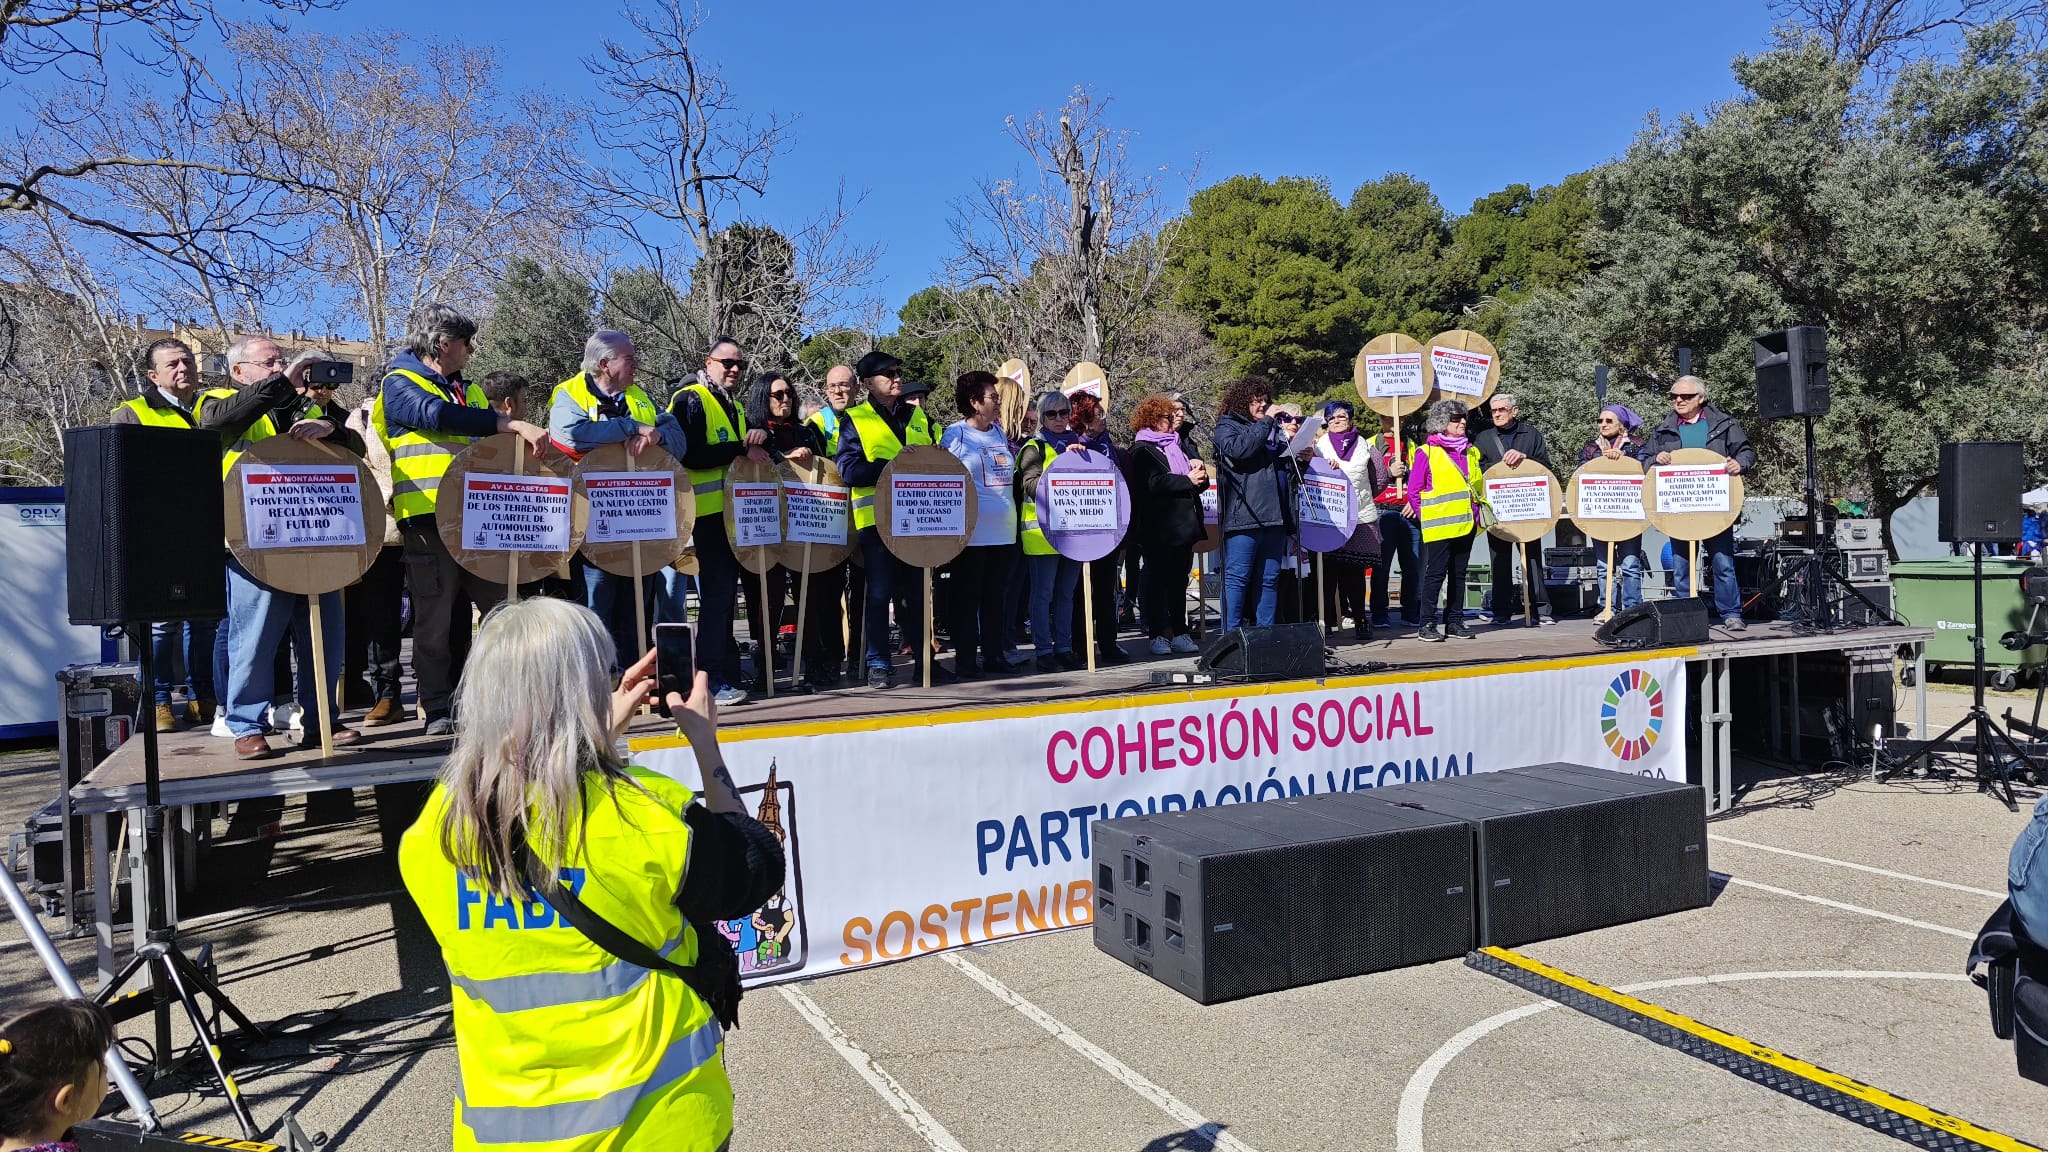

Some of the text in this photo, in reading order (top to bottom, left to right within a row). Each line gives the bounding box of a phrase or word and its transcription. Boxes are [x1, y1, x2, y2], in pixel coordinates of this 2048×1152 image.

[284, 475, 336, 483] MONTAÑANA
[262, 484, 352, 495] EN MONTAÑANA EL
[516, 485, 549, 493] CASETAS
[590, 488, 668, 498] CONSTRUCCIÓN DE
[898, 488, 963, 498] CENTRO CÍVICO YA
[1054, 488, 1113, 497] NOS QUEREMOS
[250, 496, 359, 506] PORVENIR ES OSCURO.
[468, 492, 568, 505] REVERSIÓN AL BARRIO
[592, 498, 668, 508] UN NUEVO CENTRO
[806, 498, 847, 508] CANSAREMOS
[1054, 498, 1113, 507] VIVAS, LIBRES Y
[268, 506, 345, 518] RECLAMAMOS
[468, 502, 566, 514] DE LOS TERRENOS DEL
[600, 508, 662, 518] PARA MAYORES
[788, 504, 810, 512] EXIGIR
[822, 507, 846, 515] CENTRO
[1064, 508, 1104, 516] SIN MIEDO
[20, 508, 61, 519] ORLY
[492, 512, 545, 523] CUARTEL DE
[800, 512, 828, 521] INFANCIA
[286, 519, 330, 530] FUTURO
[794, 520, 827, 529] JUVENTUD
[916, 516, 943, 524] VECINAL
[481, 522, 554, 533] AUTOMOVILISMO
[290, 535, 338, 543] CINCOMARZADA
[498, 542, 544, 550] CINCOMARZADA
[1946, 622, 1976, 630] Zaragoz
[1047, 690, 1434, 784] COHESIÓN SOCIAL
